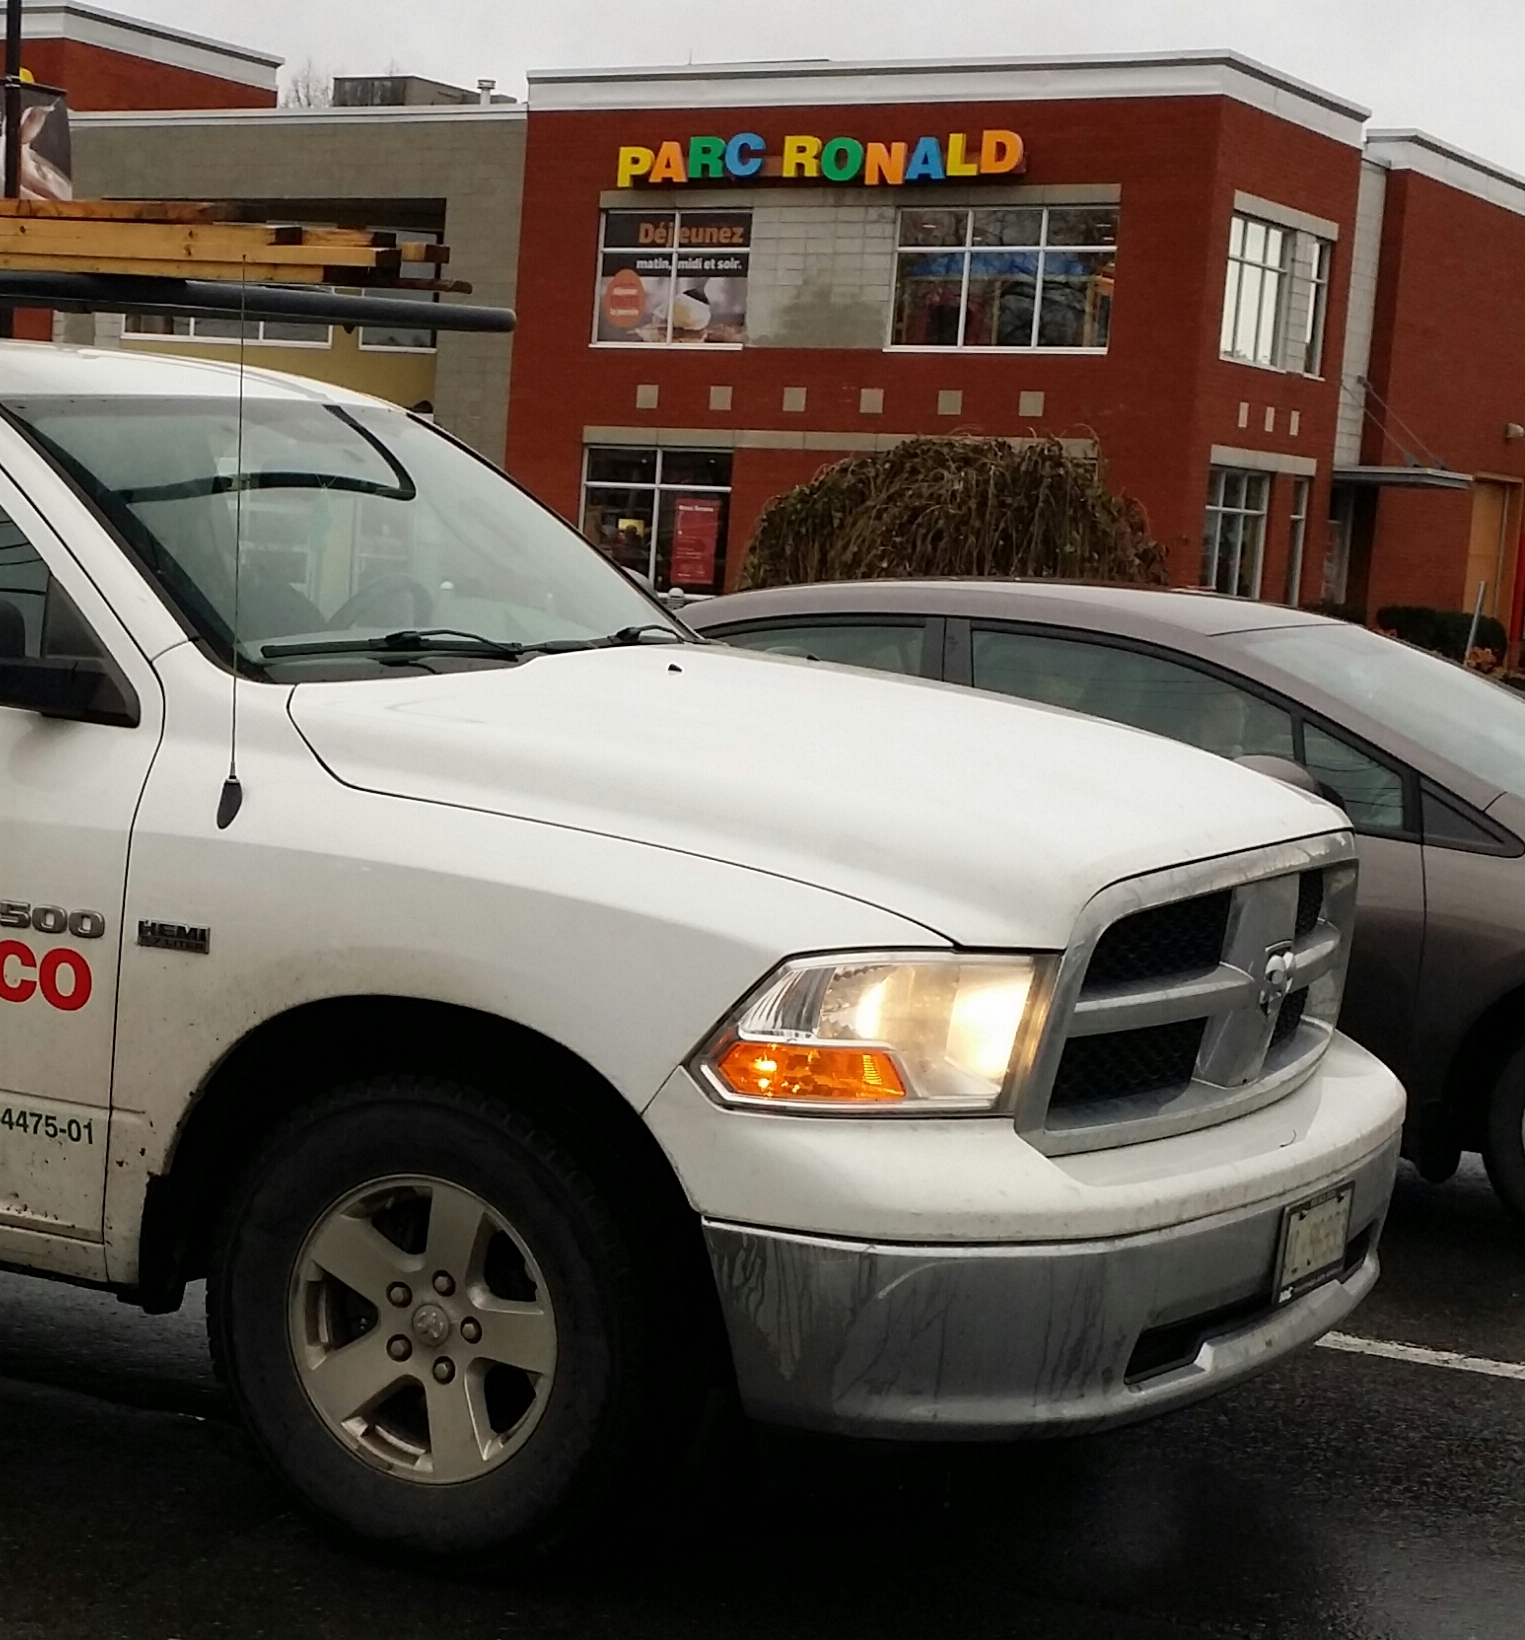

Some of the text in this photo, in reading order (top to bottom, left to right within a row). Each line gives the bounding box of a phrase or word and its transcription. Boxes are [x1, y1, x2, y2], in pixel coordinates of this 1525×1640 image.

[616, 130, 1025, 188] PARC RONALD
[638, 222, 744, 248] Déjeunez
[636, 257, 743, 270] matin, midi et soir.
[138, 919, 209, 942] HEMI
